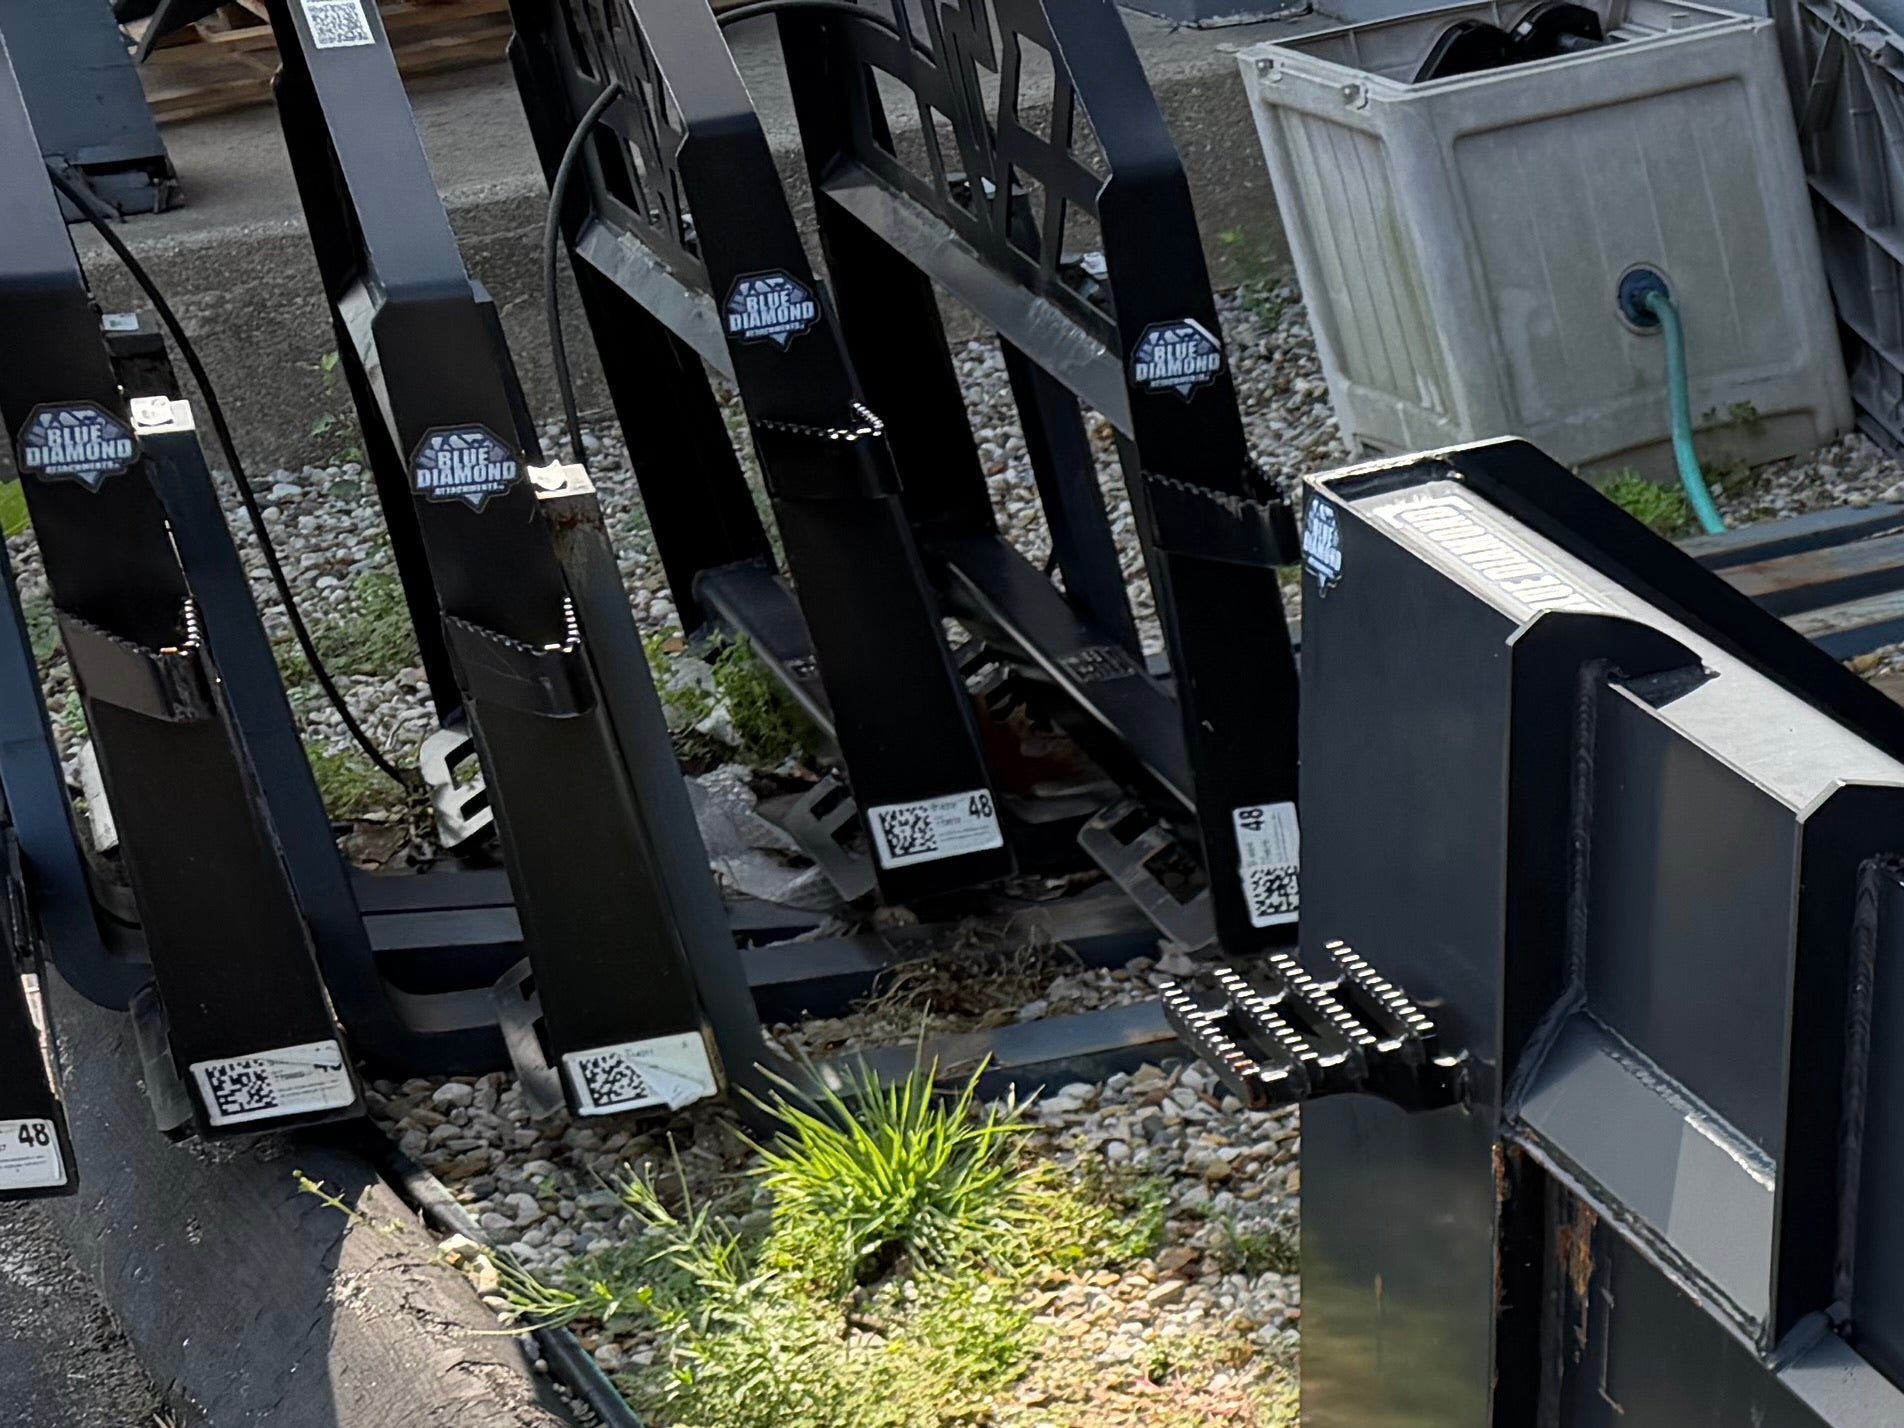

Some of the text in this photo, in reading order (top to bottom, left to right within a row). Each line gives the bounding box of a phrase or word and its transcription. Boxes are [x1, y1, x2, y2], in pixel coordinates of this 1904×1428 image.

[746, 290, 790, 313] BLUE
[729, 301, 815, 332] DIAMOND
[1154, 341, 1197, 363] BLUE
[1136, 353, 1220, 382] DIAMOND
[47, 425, 102, 447] BLUE
[25, 439, 132, 467] DIAMOND
[437, 447, 489, 470] BLUE
[416, 461, 516, 489] DIAMOND
[1399, 505, 1546, 582] DIAMOND
[968, 794, 993, 819] 48
[1238, 808, 1265, 832] 48
[18, 1123, 50, 1148] 48
